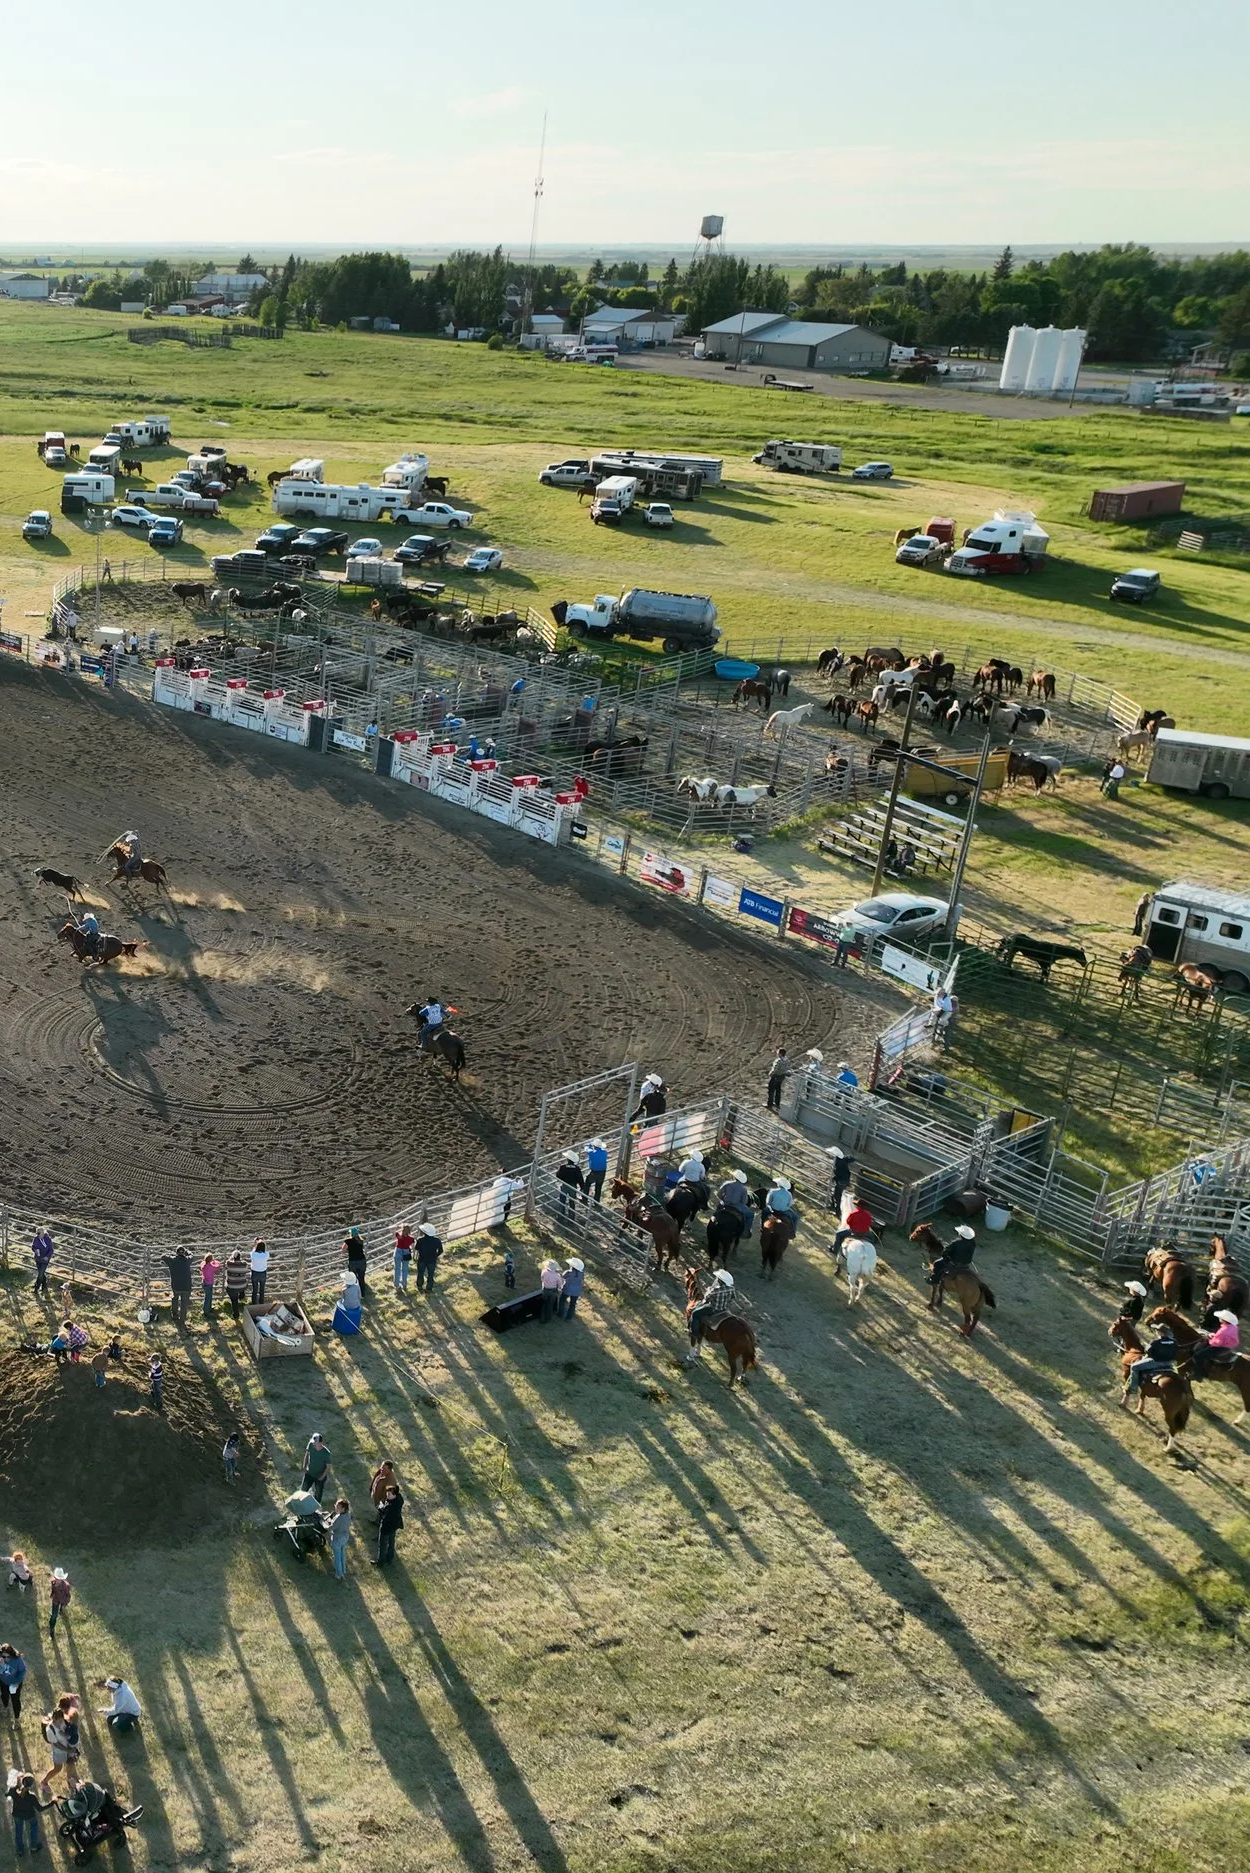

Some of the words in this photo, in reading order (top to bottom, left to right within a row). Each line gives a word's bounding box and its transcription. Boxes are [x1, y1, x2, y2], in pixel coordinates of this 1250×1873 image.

[743, 898, 755, 908] ATB
[755, 903, 779, 917] Financial
[822, 933, 840, 944] CO-O
